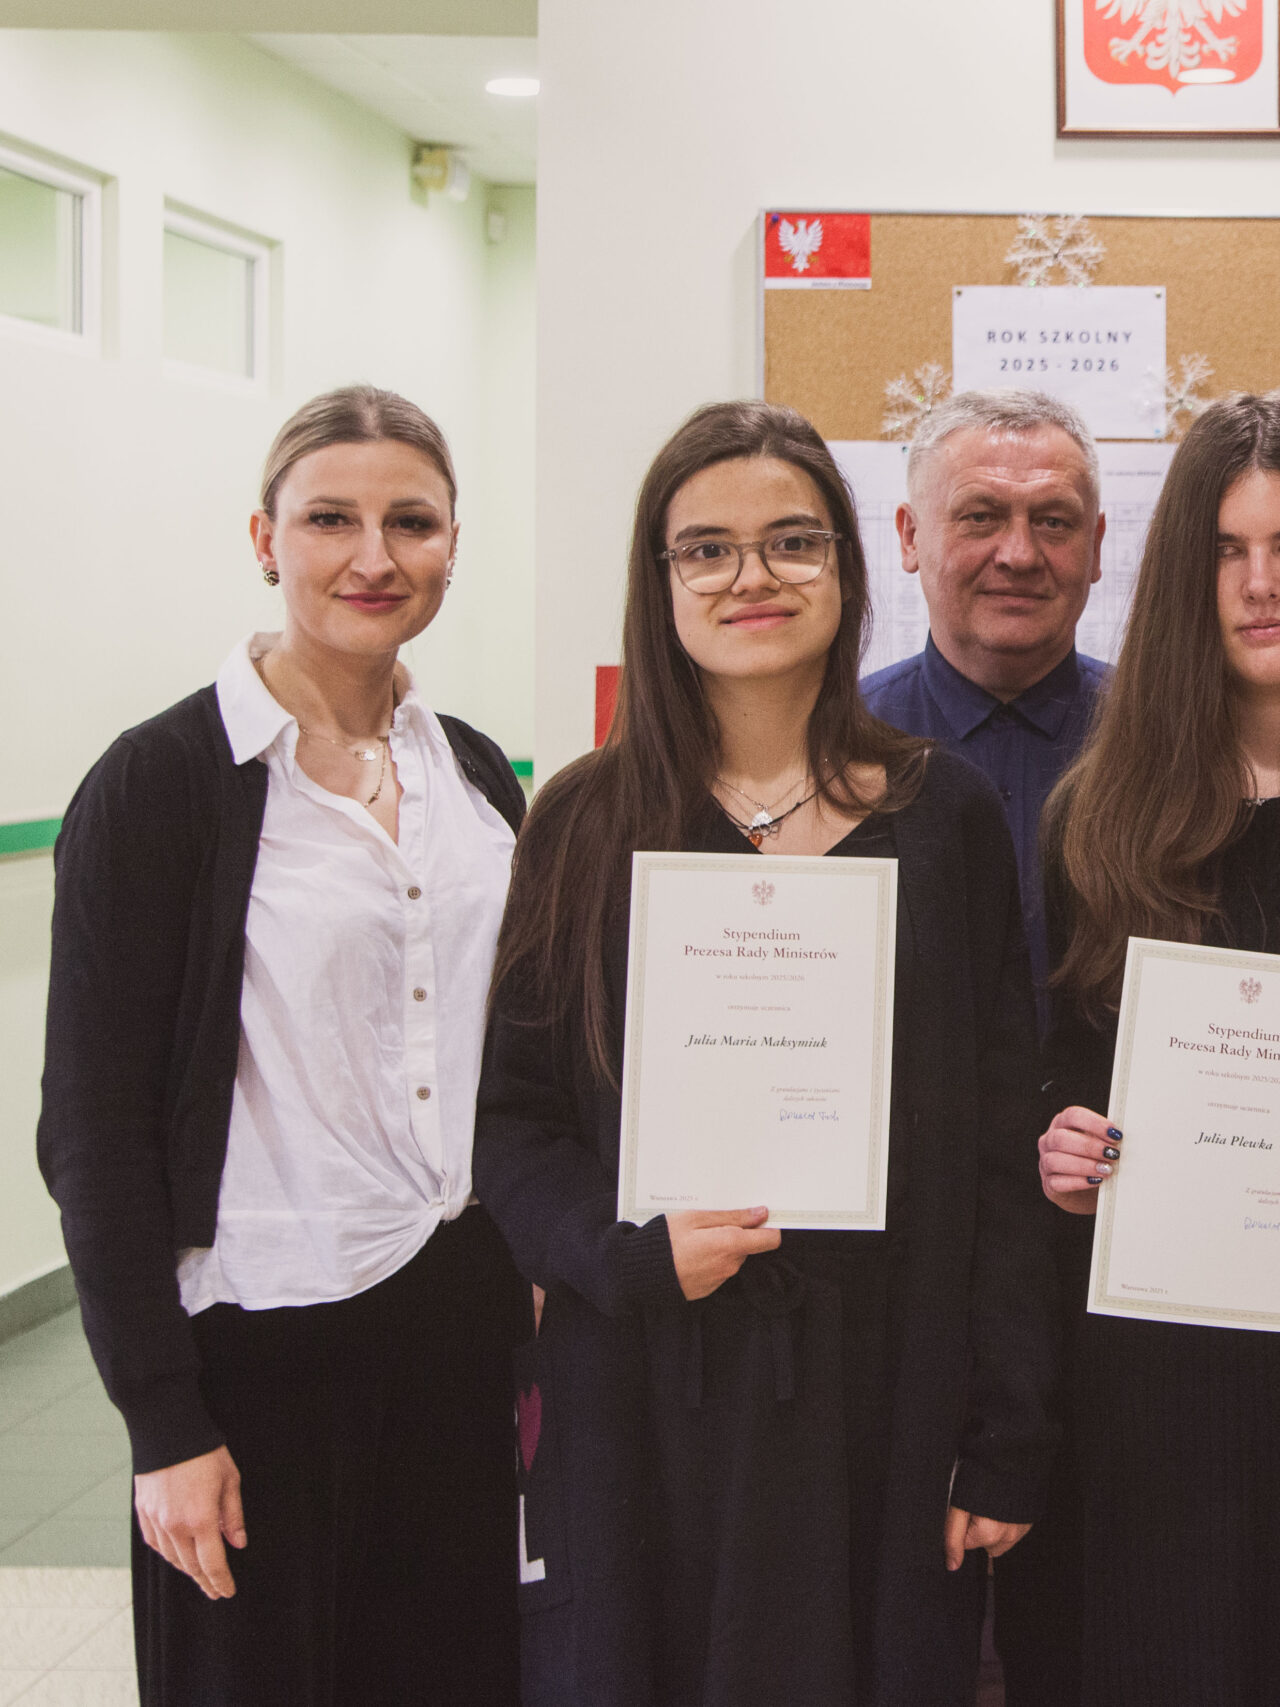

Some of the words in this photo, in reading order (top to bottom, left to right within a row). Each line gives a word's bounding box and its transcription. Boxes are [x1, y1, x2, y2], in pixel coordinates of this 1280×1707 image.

[986, 329, 1028, 345] ROK
[1039, 329, 1134, 345] SZKOLNY
[999, 357, 1049, 373] 2025
[1070, 357, 1121, 373] 2026
[722, 927, 801, 943] Stypendium
[684, 945, 732, 958] Prezesa
[737, 946, 769, 960] Rady
[773, 946, 839, 960] Ministrów
[684, 1034, 718, 1048] Julia
[720, 1035, 757, 1047] Maria
[760, 1035, 829, 1050] Maksymiuk
[1168, 1036, 1216, 1054] Prezesa
[1220, 1043, 1252, 1061] Rady
[1194, 1131, 1227, 1145] Julia
[1230, 1135, 1273, 1151] Plewka
